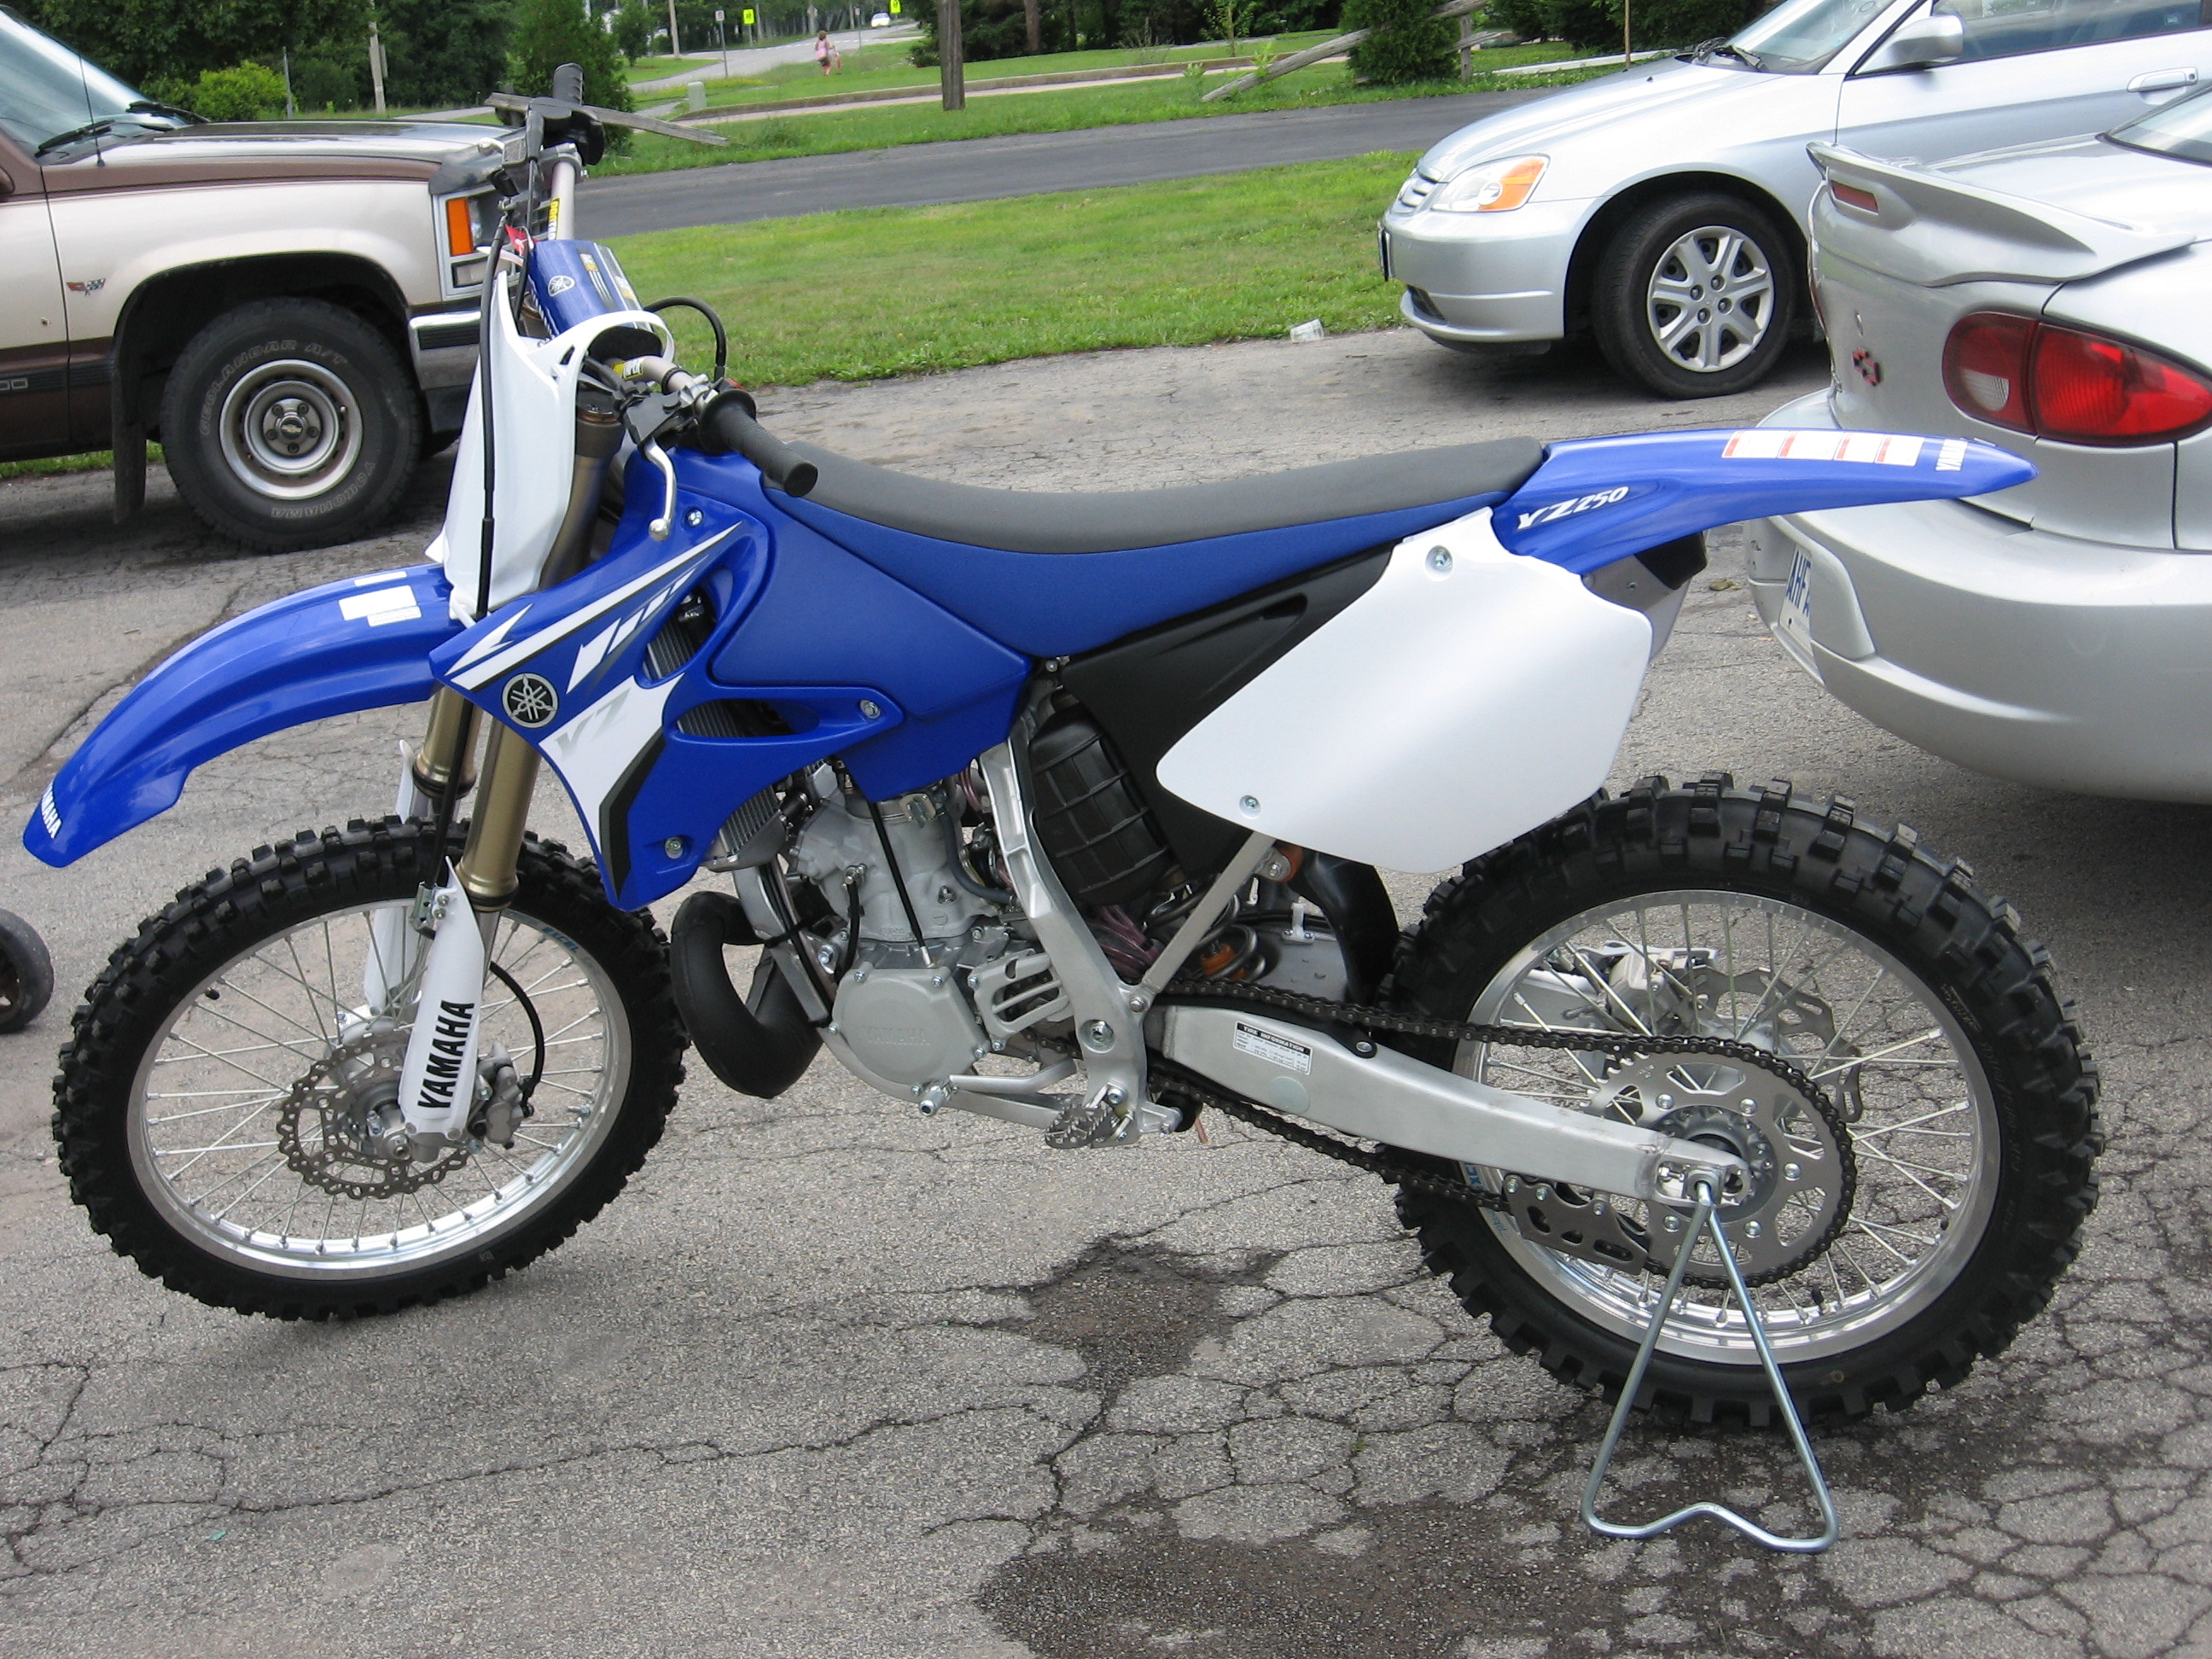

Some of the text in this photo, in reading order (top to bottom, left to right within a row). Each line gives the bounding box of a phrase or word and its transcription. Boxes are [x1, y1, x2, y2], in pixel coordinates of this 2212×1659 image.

[271, 461, 376, 519] YOKOHAMA
[1516, 486, 1630, 531] YZ250
[542, 926, 579, 954] EXCEL
[417, 999, 475, 1109] YAMAHA
